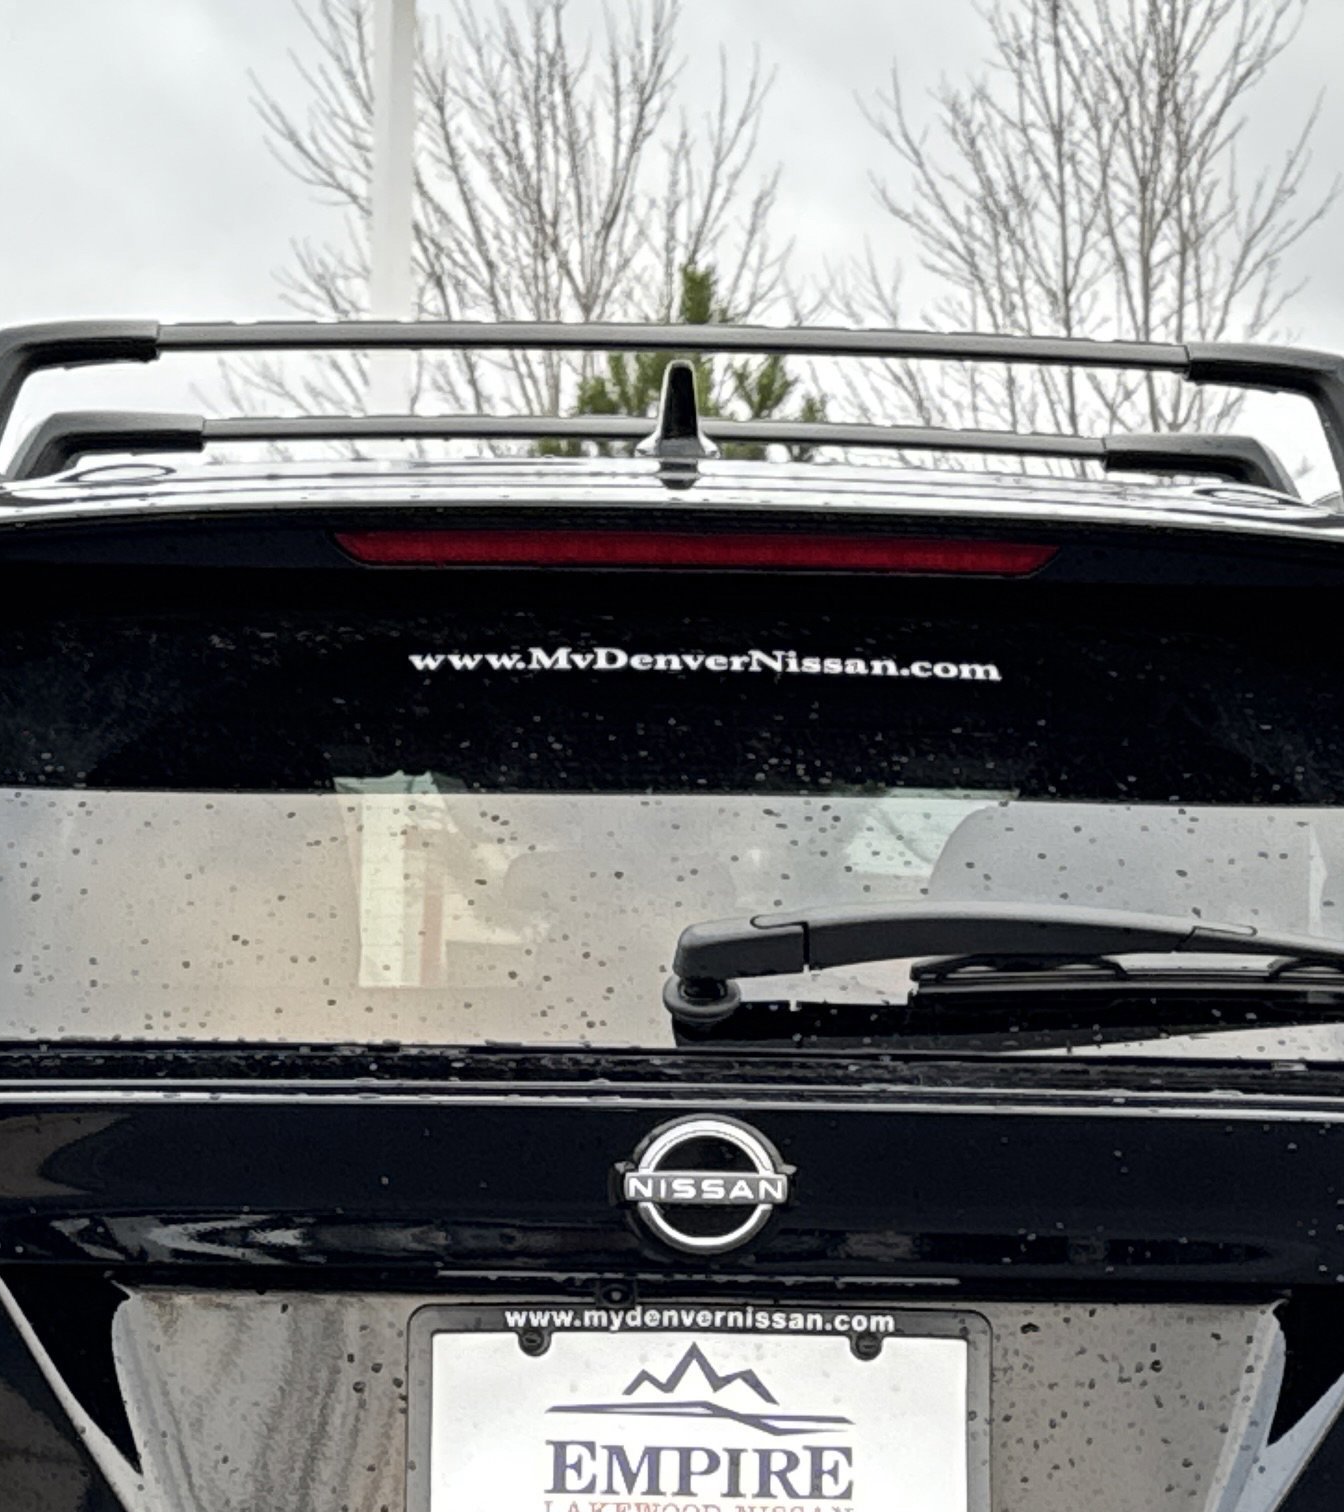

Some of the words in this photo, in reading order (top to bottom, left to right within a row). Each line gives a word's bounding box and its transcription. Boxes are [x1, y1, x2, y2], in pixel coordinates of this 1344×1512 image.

[628, 1177, 783, 1200] NISSAN
[505, 1305, 895, 1332] www.mydenvernissan.com
[544, 1439, 854, 1500] EMPIRE
